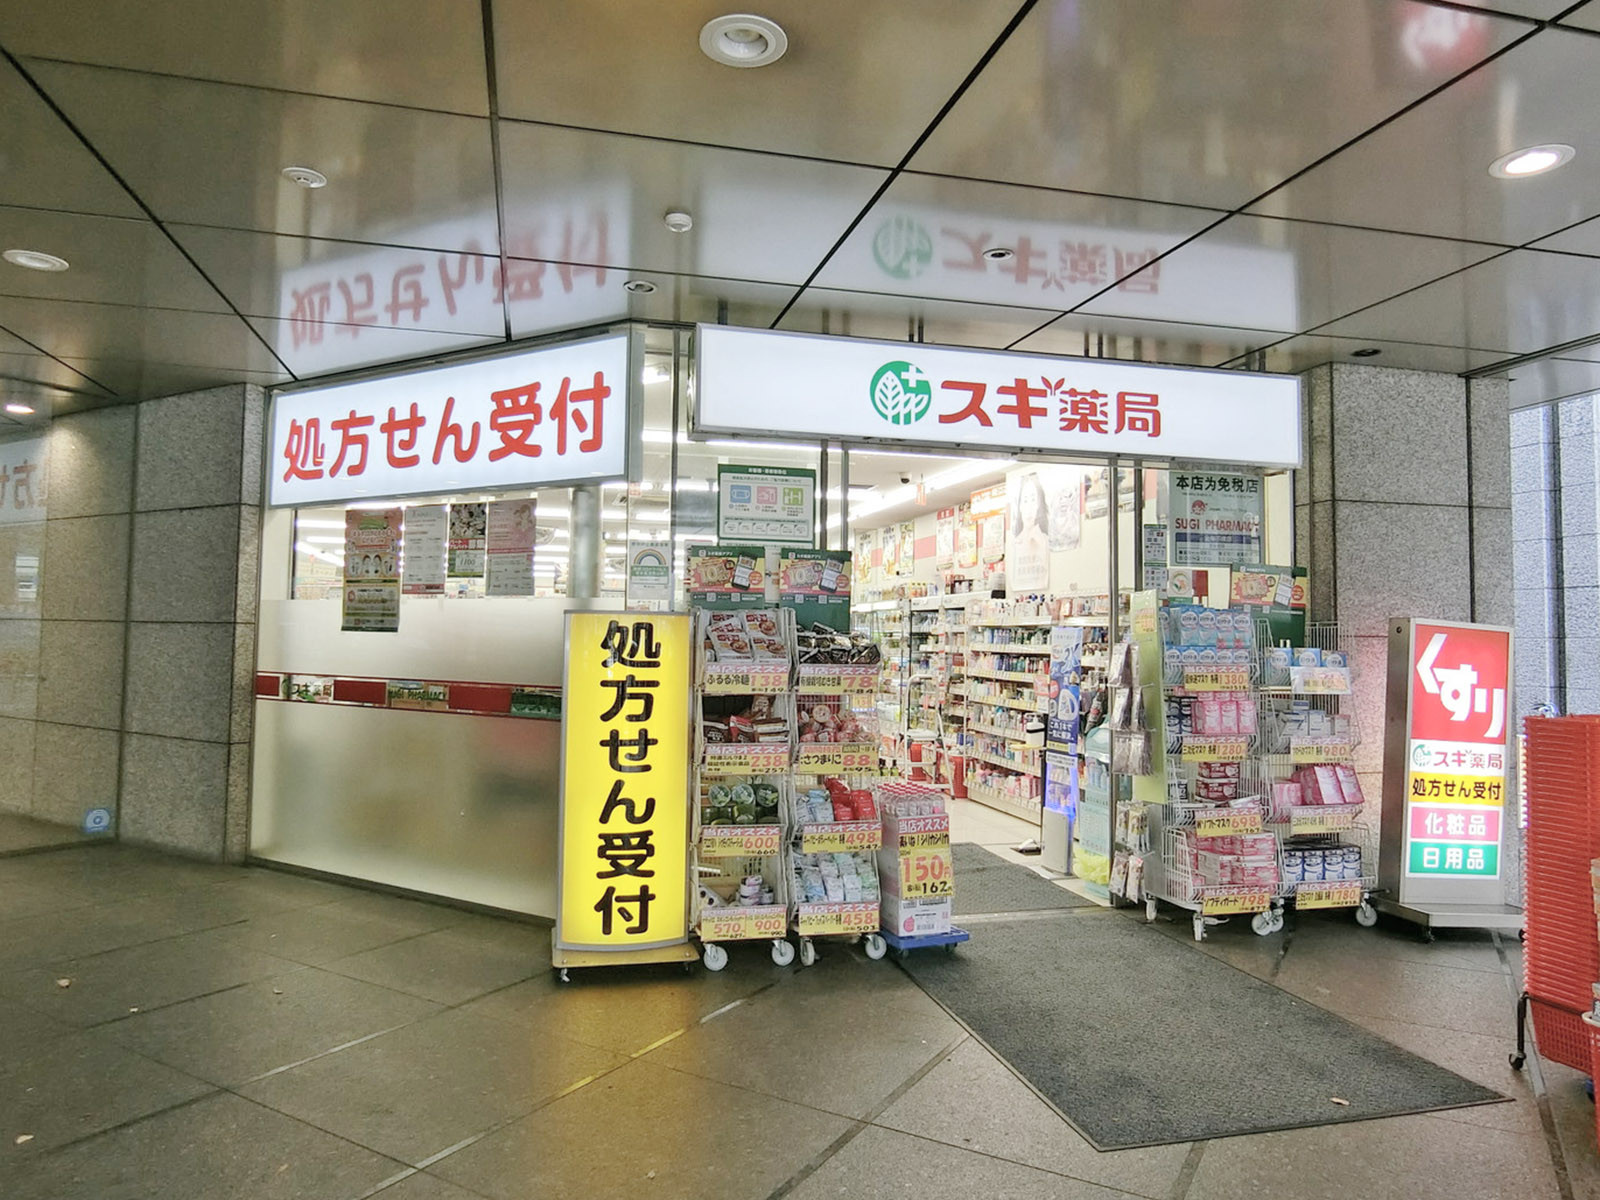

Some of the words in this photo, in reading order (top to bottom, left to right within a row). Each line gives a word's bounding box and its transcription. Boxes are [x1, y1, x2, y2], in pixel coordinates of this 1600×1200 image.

[938, 376, 1161, 438] スギ薬局
[283, 370, 612, 483] 処方せん受付
[1175, 475, 1259, 494] 本店为免税店
[1175, 518, 1200, 530] SUGI
[1416, 633, 1504, 738] くすり
[1433, 749, 1503, 769] スギ薬局
[594, 620, 661, 936] 処方せん受付
[1412, 778, 1502, 801] 処方せん受付
[898, 818, 949, 834] 当店オススメ
[1424, 812, 1487, 836] 化粧品
[1423, 847, 1485, 870] 日用品
